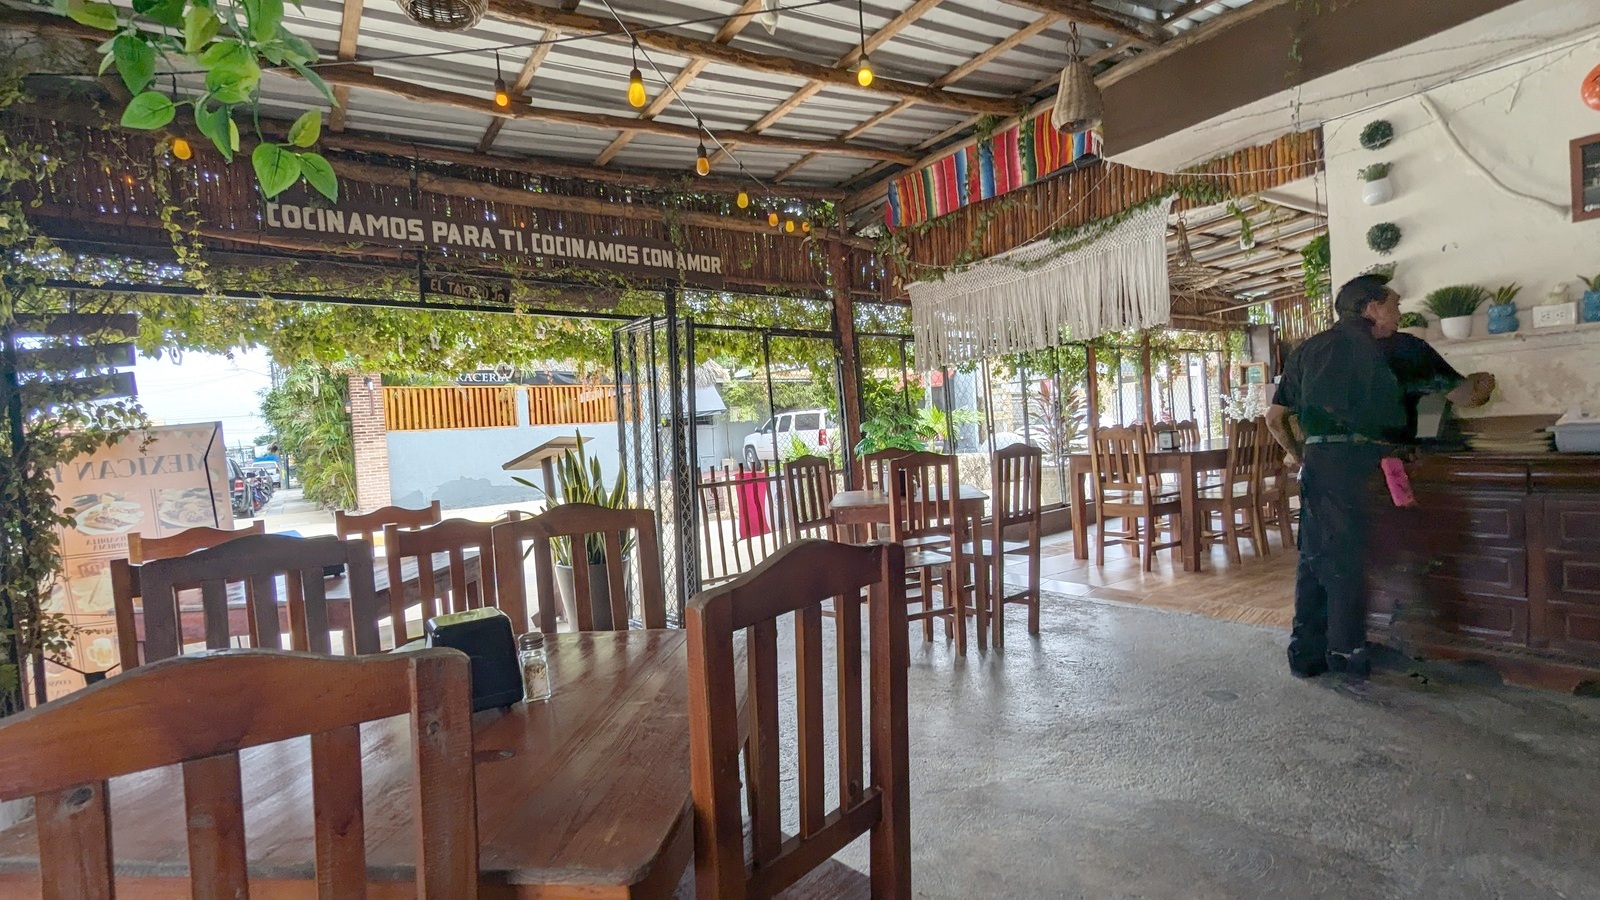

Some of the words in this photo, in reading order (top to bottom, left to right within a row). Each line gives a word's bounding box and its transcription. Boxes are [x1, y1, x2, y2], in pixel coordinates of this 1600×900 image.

[266, 203, 425, 242] COCINAMOS
[431, 220, 496, 249] PARA
[498, 228, 529, 255] TI,
[531, 232, 639, 265] COCINAMOS
[643, 247, 674, 269] CON
[676, 251, 722, 274] AMOR
[430, 278, 444, 293] EL
